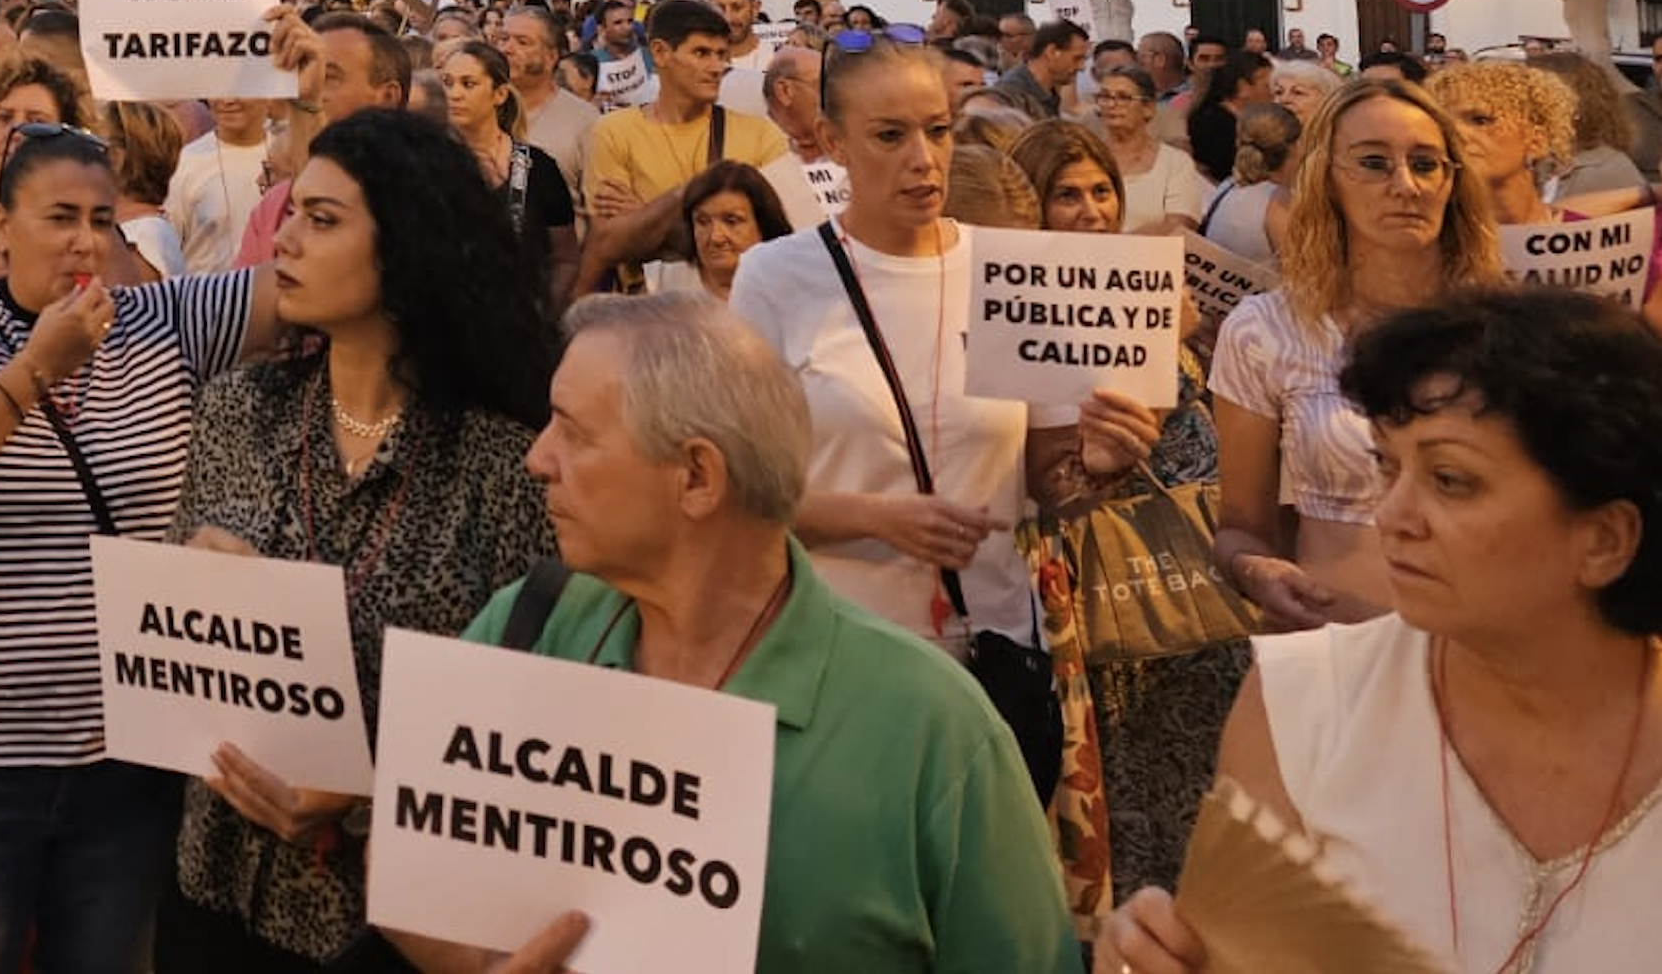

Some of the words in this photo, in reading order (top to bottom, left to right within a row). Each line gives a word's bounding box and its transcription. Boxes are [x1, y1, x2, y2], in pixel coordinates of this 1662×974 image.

[102, 31, 273, 59] TARIFAZO
[808, 169, 833, 185] MI
[1525, 230, 1592, 256] CON
[1601, 222, 1632, 249] MI
[984, 261, 1048, 287] POR
[1057, 266, 1096, 290] UN
[1105, 269, 1175, 293] AGUA
[1219, 270, 1253, 291] UN
[1610, 254, 1644, 280] NO
[983, 295, 1117, 329] PÚBLICA
[1124, 306, 1140, 330] Y
[1146, 307, 1173, 330] DE
[1018, 338, 1148, 368] CALIDAD
[1125, 551, 1175, 575] THE
[139, 602, 304, 661] ALCALDE
[115, 652, 345, 721] MENTIROSO
[443, 724, 701, 821] ALCALDE
[395, 784, 742, 910] MENTIROSO
